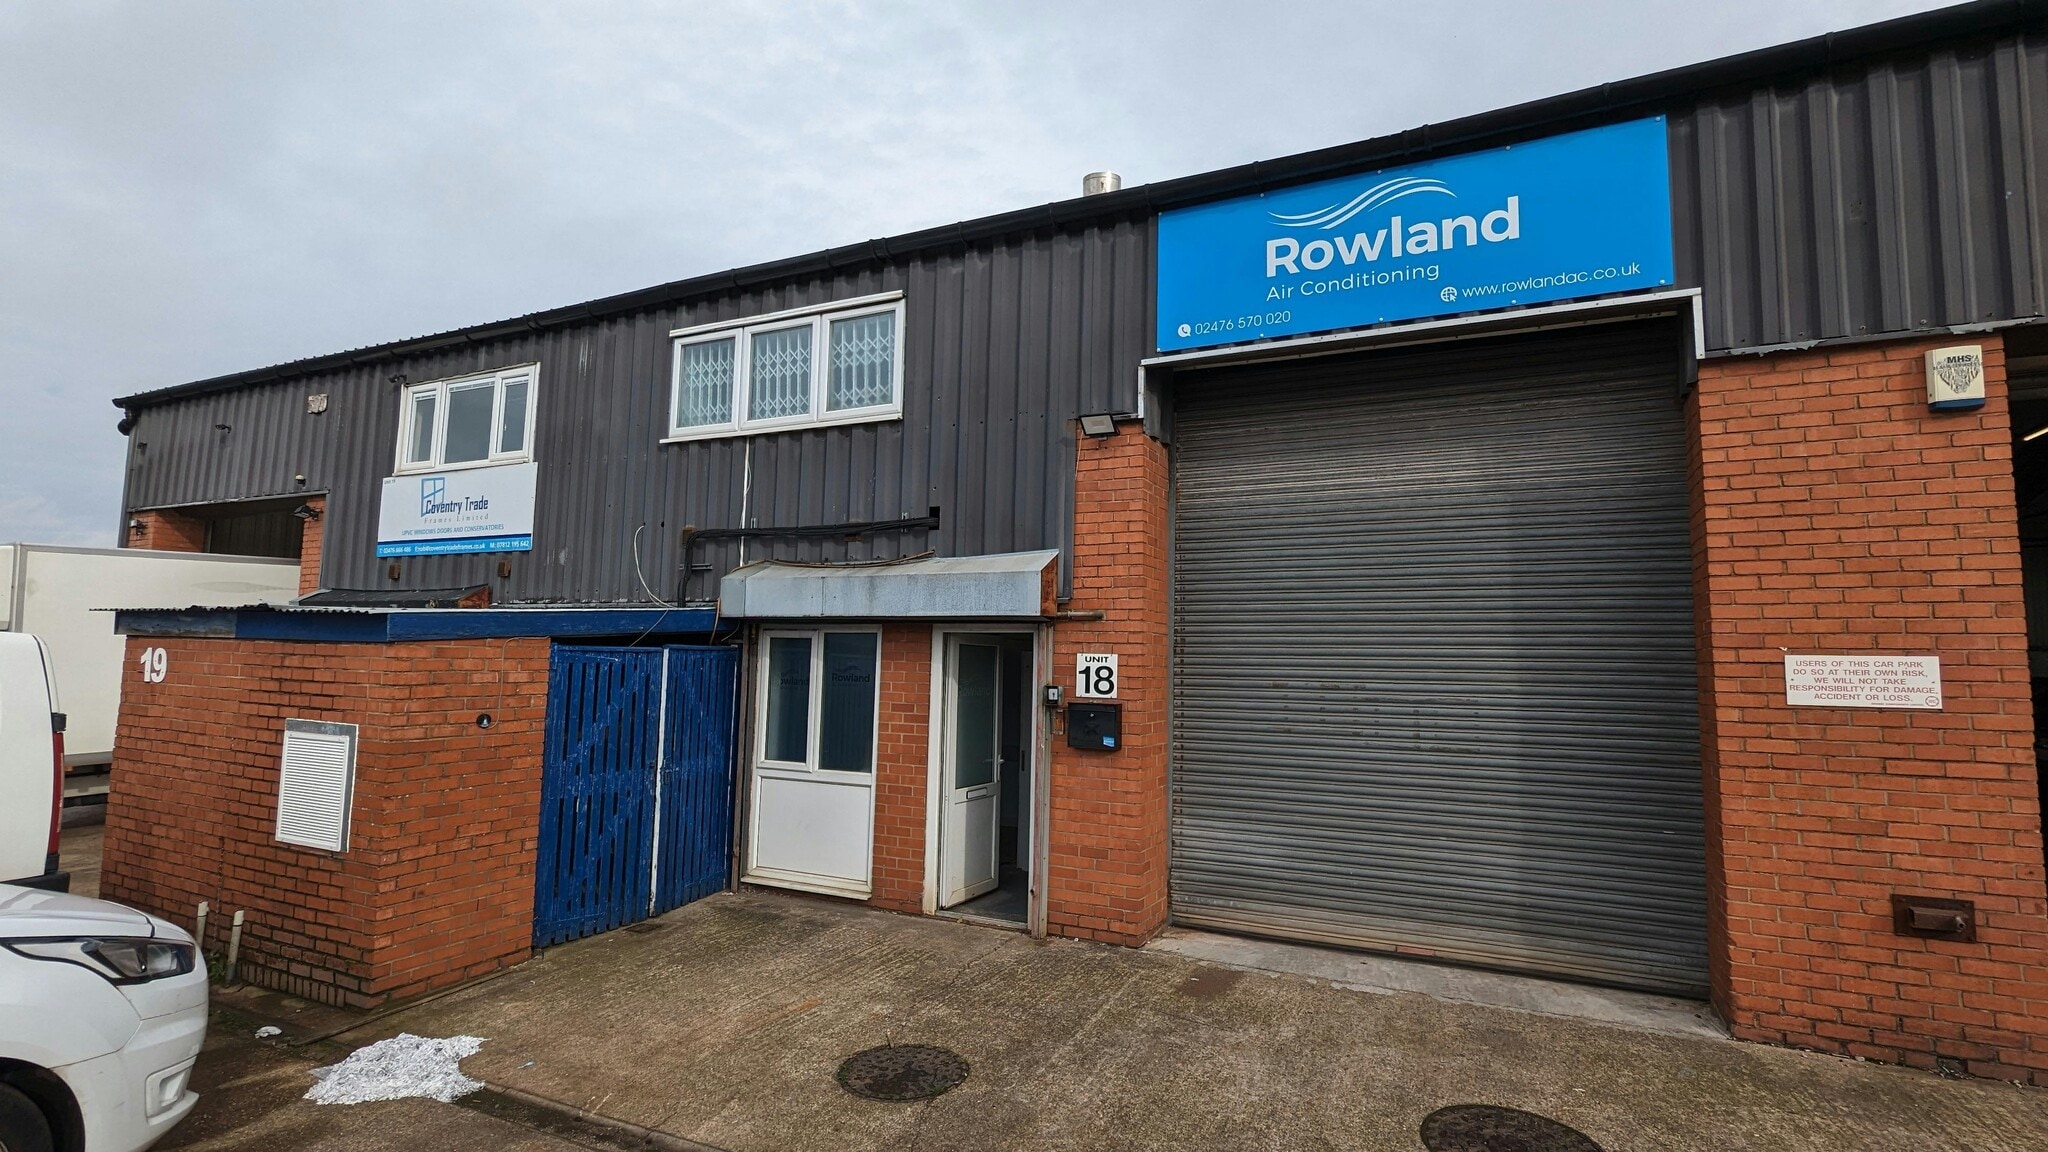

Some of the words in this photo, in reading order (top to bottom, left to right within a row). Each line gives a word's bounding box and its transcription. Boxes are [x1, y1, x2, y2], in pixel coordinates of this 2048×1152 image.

[1266, 195, 1520, 278] Rowland
[1266, 284, 1294, 301] Air
[1300, 264, 1440, 296] Conditioning
[1462, 262, 1641, 297] www.rowlandac.co.uk
[1194, 319, 1234, 335] 02476
[1237, 314, 1262, 328] 570
[1265, 310, 1291, 325] 020
[1947, 354, 1972, 364] MHS
[425, 500, 462, 515] Coventry
[465, 495, 489, 511] Trade
[456, 513, 489, 522] Limited
[464, 523, 504, 532] CONSERVATORIES
[140, 647, 168, 682] 19
[1902, 670, 1928, 678] RISK,
[832, 673, 870, 682] Rowland
[1078, 665, 1115, 695] 18
